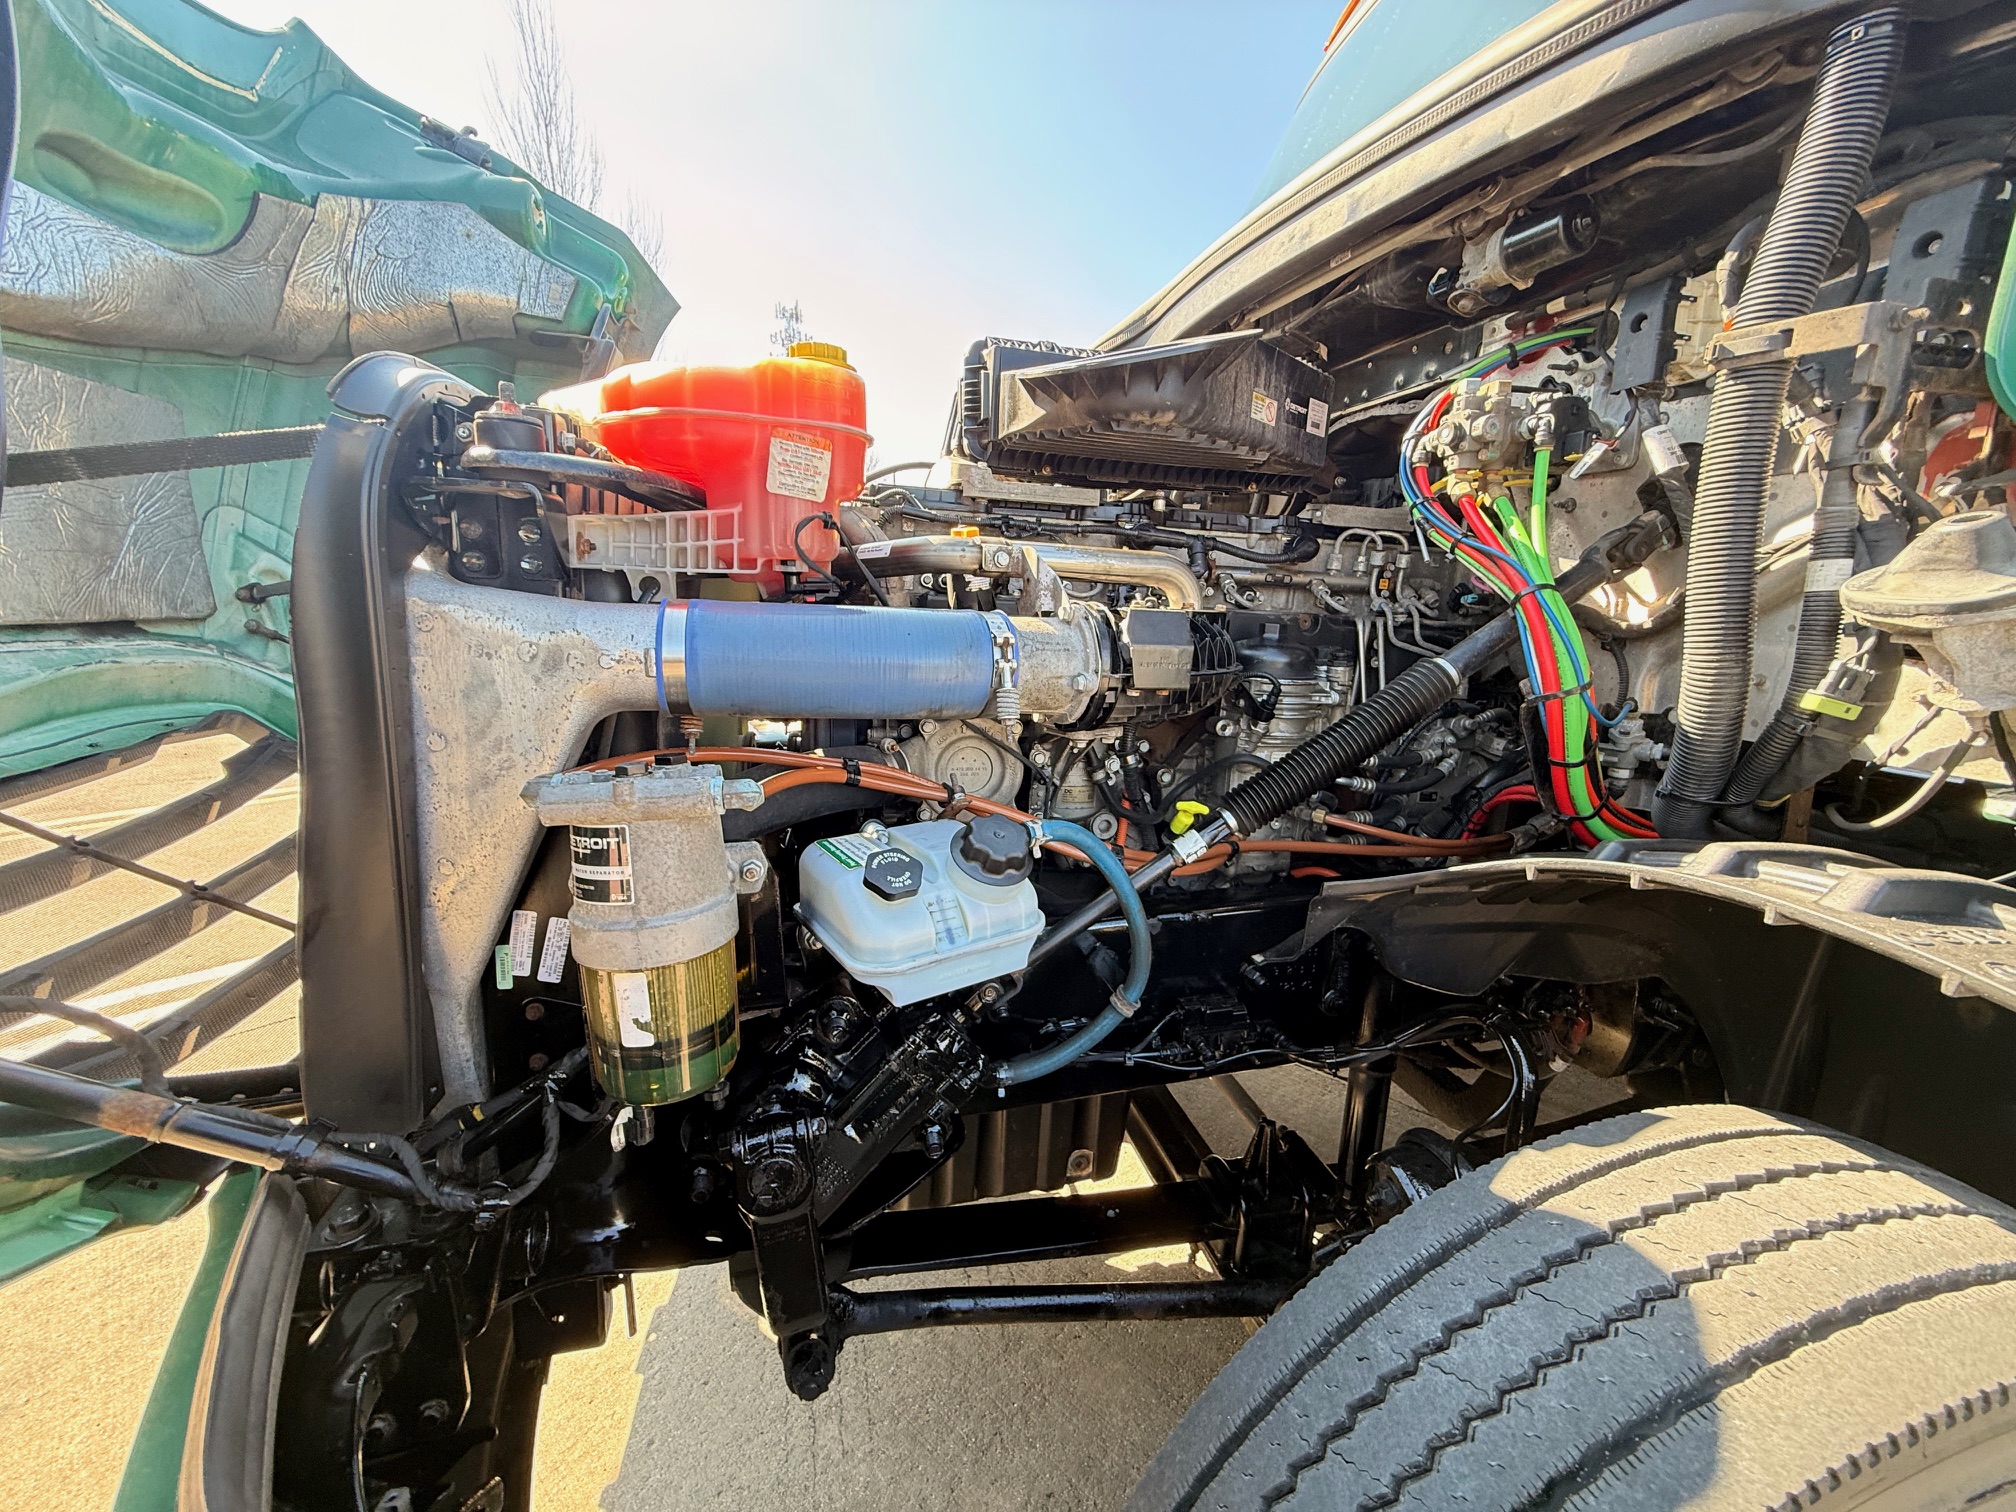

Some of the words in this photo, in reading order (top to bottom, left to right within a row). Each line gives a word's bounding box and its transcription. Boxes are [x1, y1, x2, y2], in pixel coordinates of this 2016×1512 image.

[788, 432, 819, 444] ATTENTION
[570, 834, 619, 849] ETROIT
[871, 854, 883, 869] POWER
[883, 852, 910, 862] STEERING
[880, 857, 899, 865] FLUID
